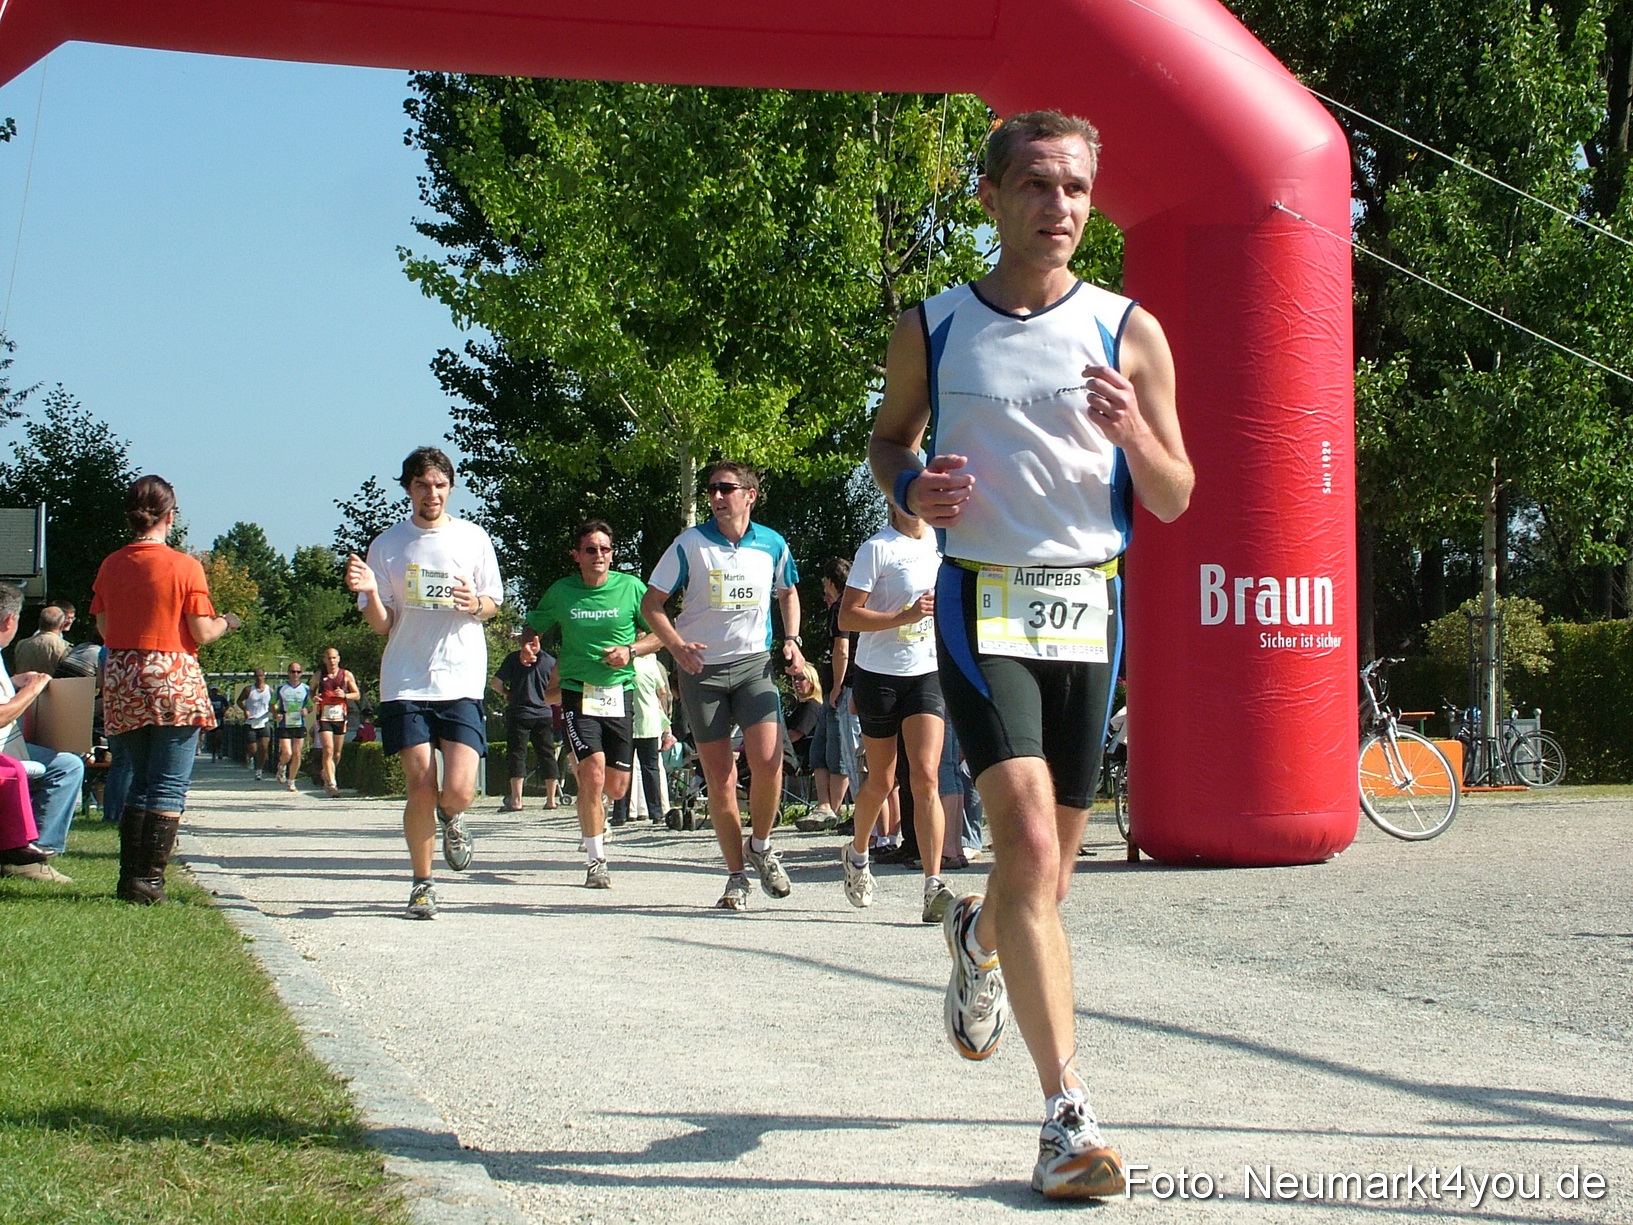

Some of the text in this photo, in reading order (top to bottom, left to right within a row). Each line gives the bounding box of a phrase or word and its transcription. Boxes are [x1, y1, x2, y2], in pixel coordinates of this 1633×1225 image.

[1322, 440, 1332, 494] Seit 1929
[421, 568, 449, 579] Thomas
[723, 573, 746, 582] Martin
[1013, 567, 1082, 588] Andreas
[426, 584, 453, 598] 229
[729, 587, 754, 599] 465
[1199, 563, 1334, 627] Braun
[982, 593, 991, 609] B
[570, 607, 620, 621] Sinupret
[1027, 600, 1089, 631] 307
[1260, 632, 1342, 649] Sicher ist sicher
[599, 697, 617, 707] 343
[565, 711, 588, 751] Sinupret
